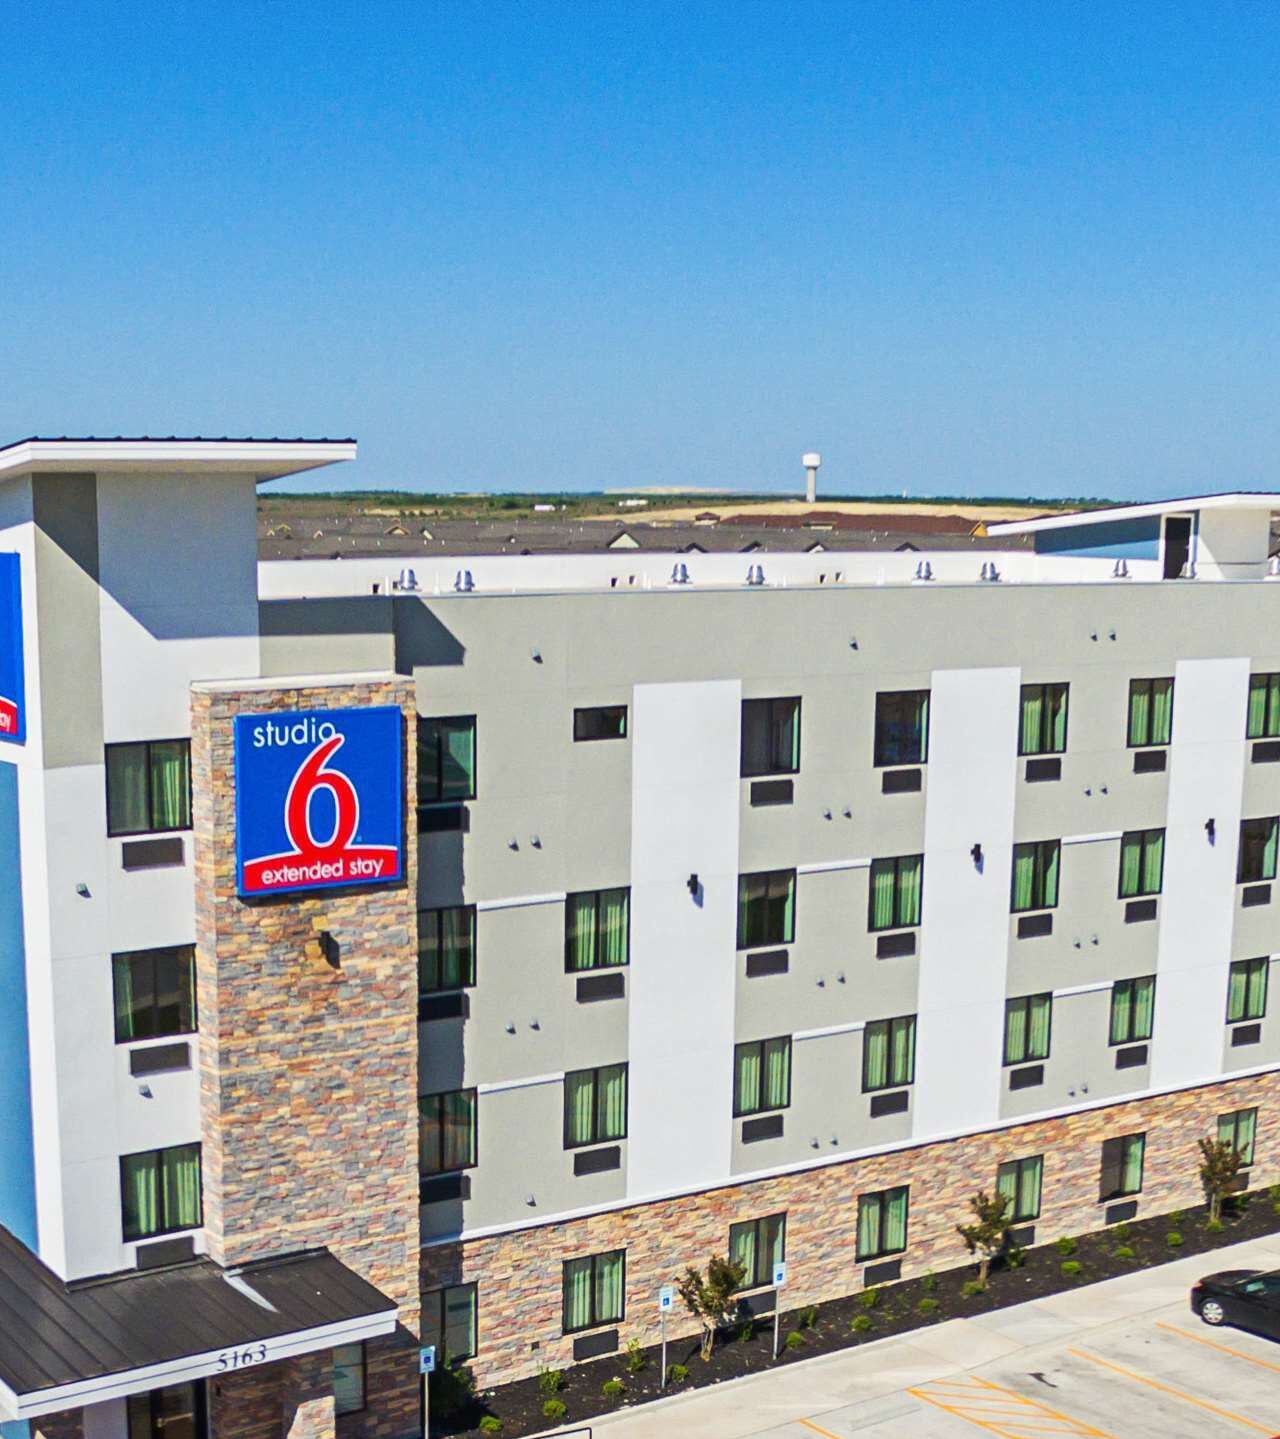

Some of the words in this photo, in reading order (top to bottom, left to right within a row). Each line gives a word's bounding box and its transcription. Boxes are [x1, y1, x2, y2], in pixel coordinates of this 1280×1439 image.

[253, 718, 336, 748] studio
[284, 733, 360, 854] 6
[261, 858, 344, 887] extended
[349, 856, 384, 881] stay
[216, 1344, 267, 1372] 5163
